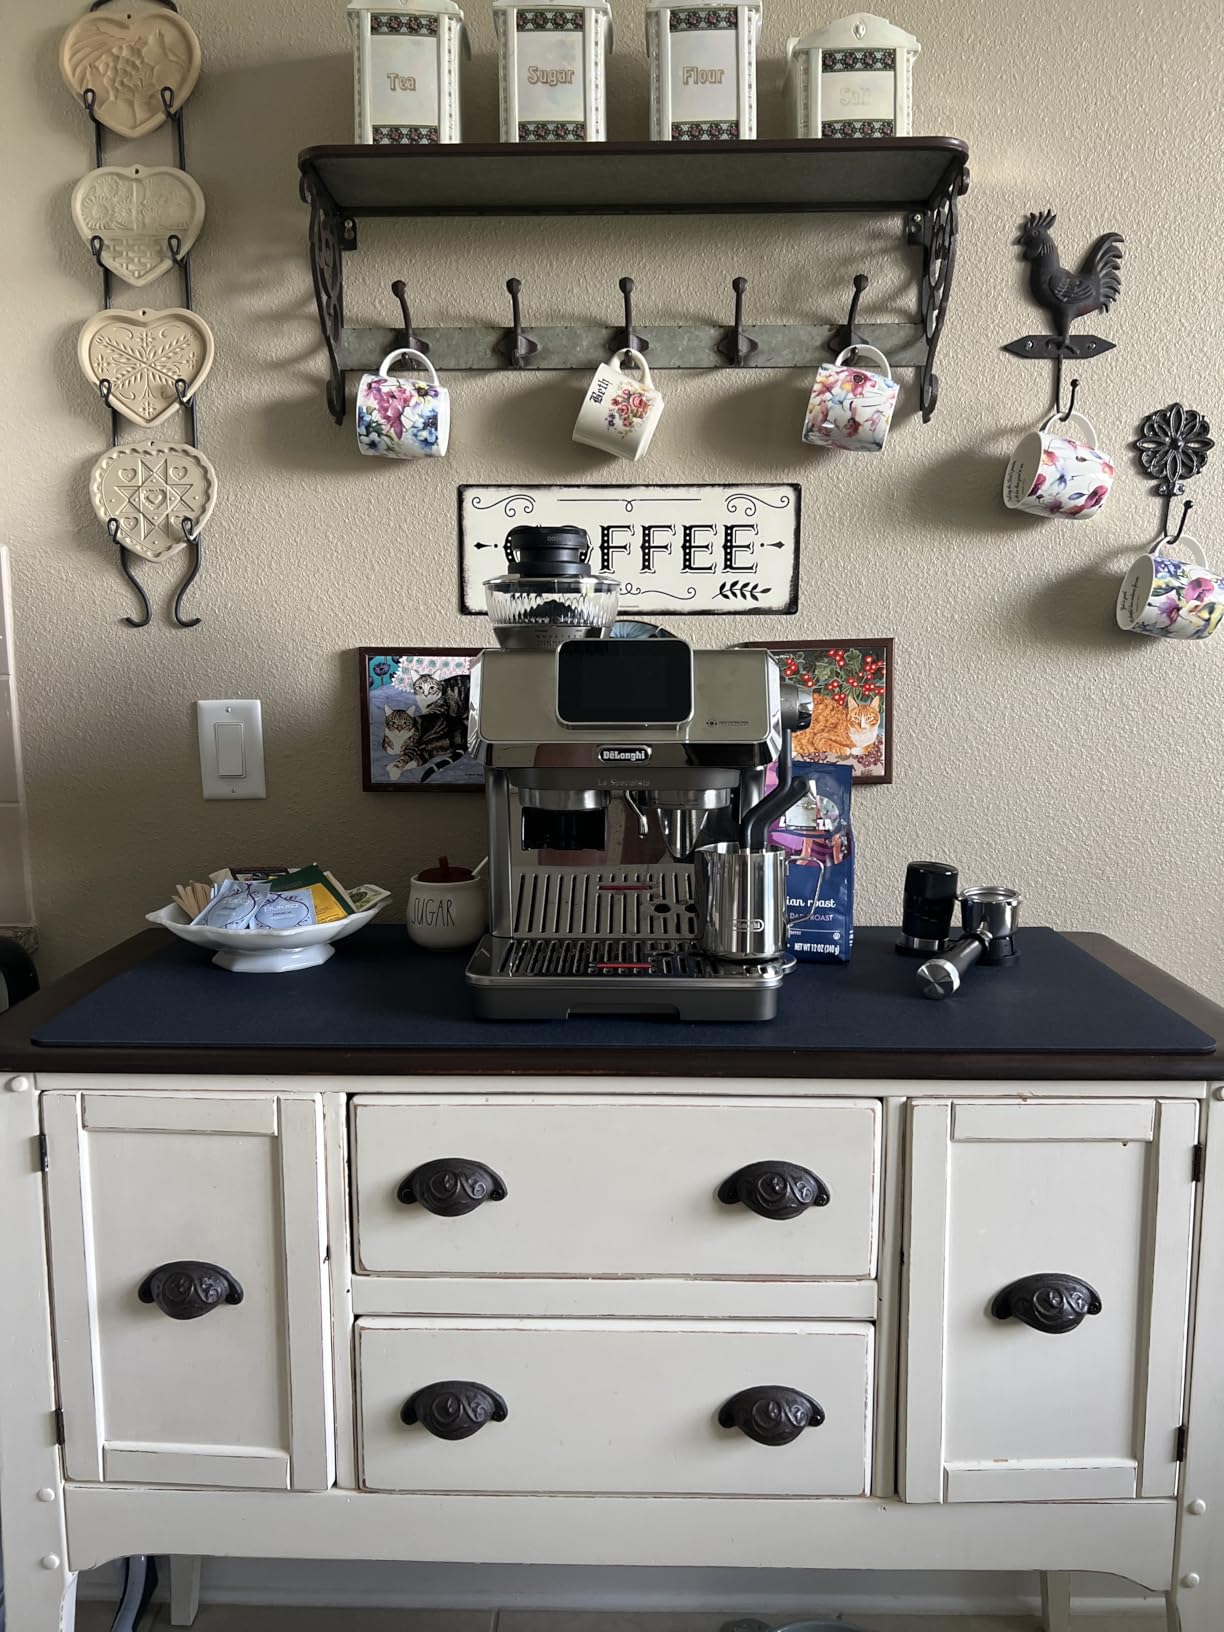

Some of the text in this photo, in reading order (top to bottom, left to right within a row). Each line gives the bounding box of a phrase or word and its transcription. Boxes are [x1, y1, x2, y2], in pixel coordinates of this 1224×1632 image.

[386, 73, 417, 92] Tea
[528, 66, 575, 87] Sugar
[682, 66, 725, 86] Flour
[589, 378, 612, 404] Beth
[503, 523, 760, 575] FFEE
[785, 896, 806, 907] ian
[410, 897, 456, 928] SUGAR
[794, 942, 803, 951] NET
[803, 943, 811, 952] WT
[811, 943, 817, 953] 12
[817, 943, 825, 953] OZ
